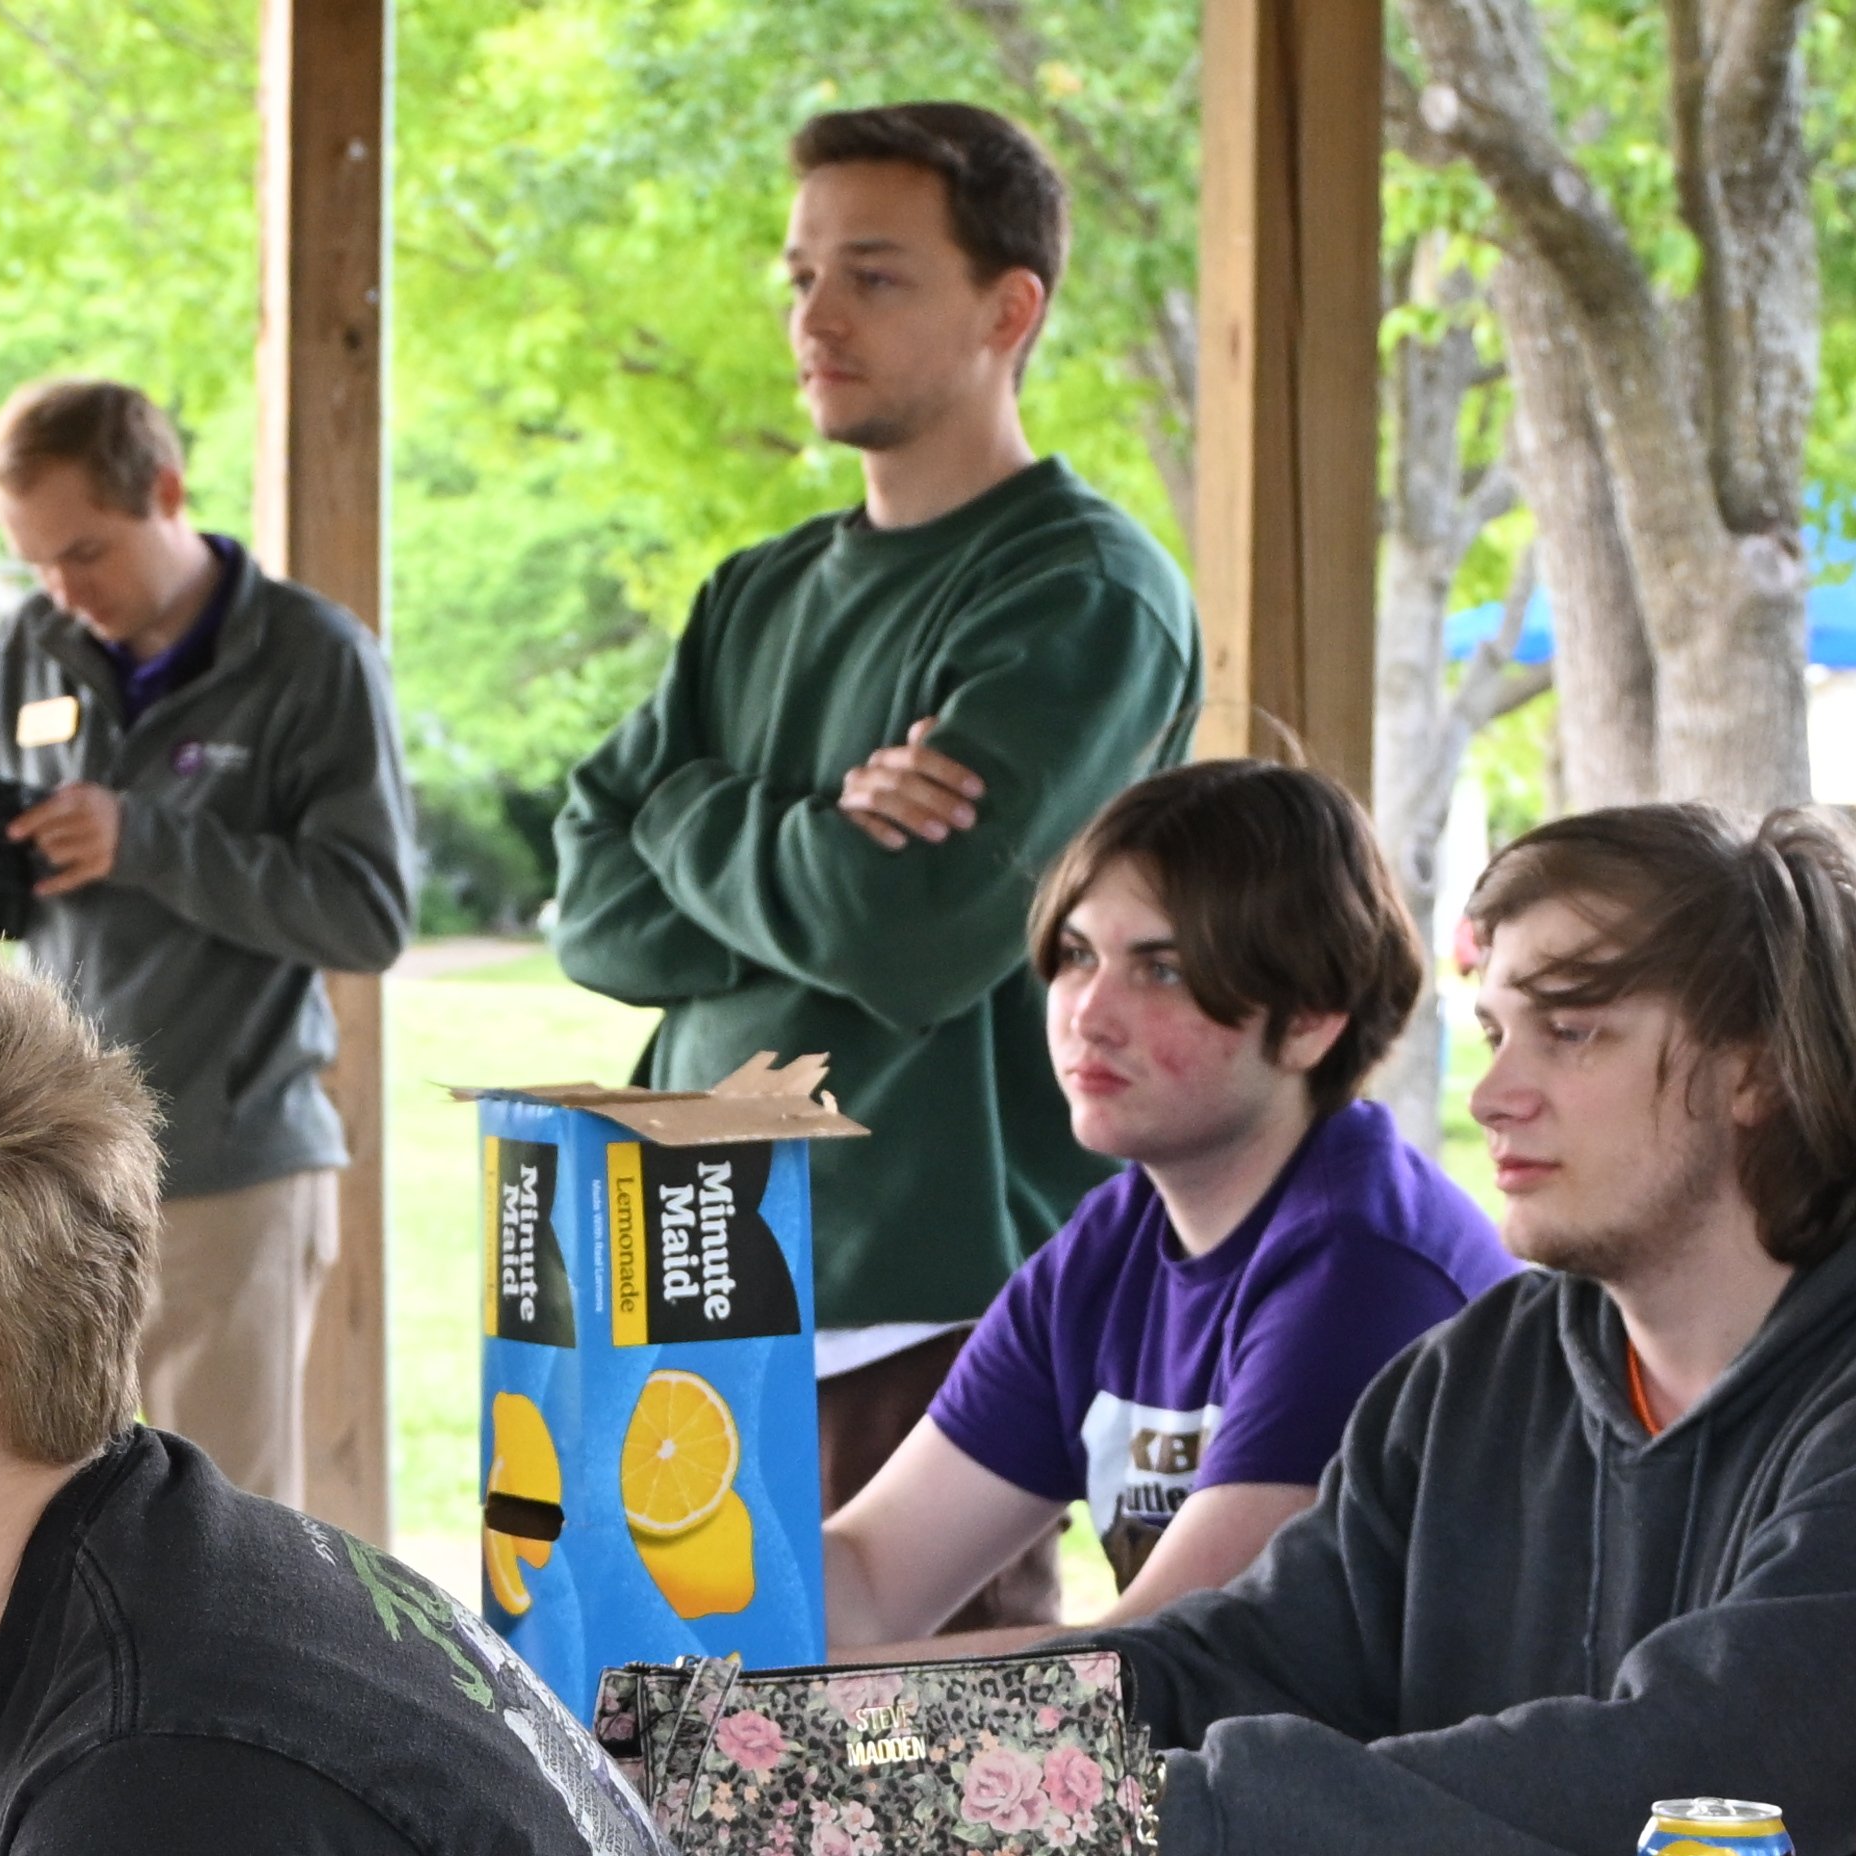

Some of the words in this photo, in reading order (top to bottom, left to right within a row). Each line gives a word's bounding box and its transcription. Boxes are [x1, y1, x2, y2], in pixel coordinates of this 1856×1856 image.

[502, 1184, 521, 1297] Maid
[519, 1163, 539, 1323] Minute
[614, 1175, 643, 1314] Lemonade
[658, 1183, 700, 1303] Maid
[696, 1160, 737, 1322] Minute
[846, 1735, 927, 1767] MADDEN
[855, 1702, 913, 1732] STEVE
